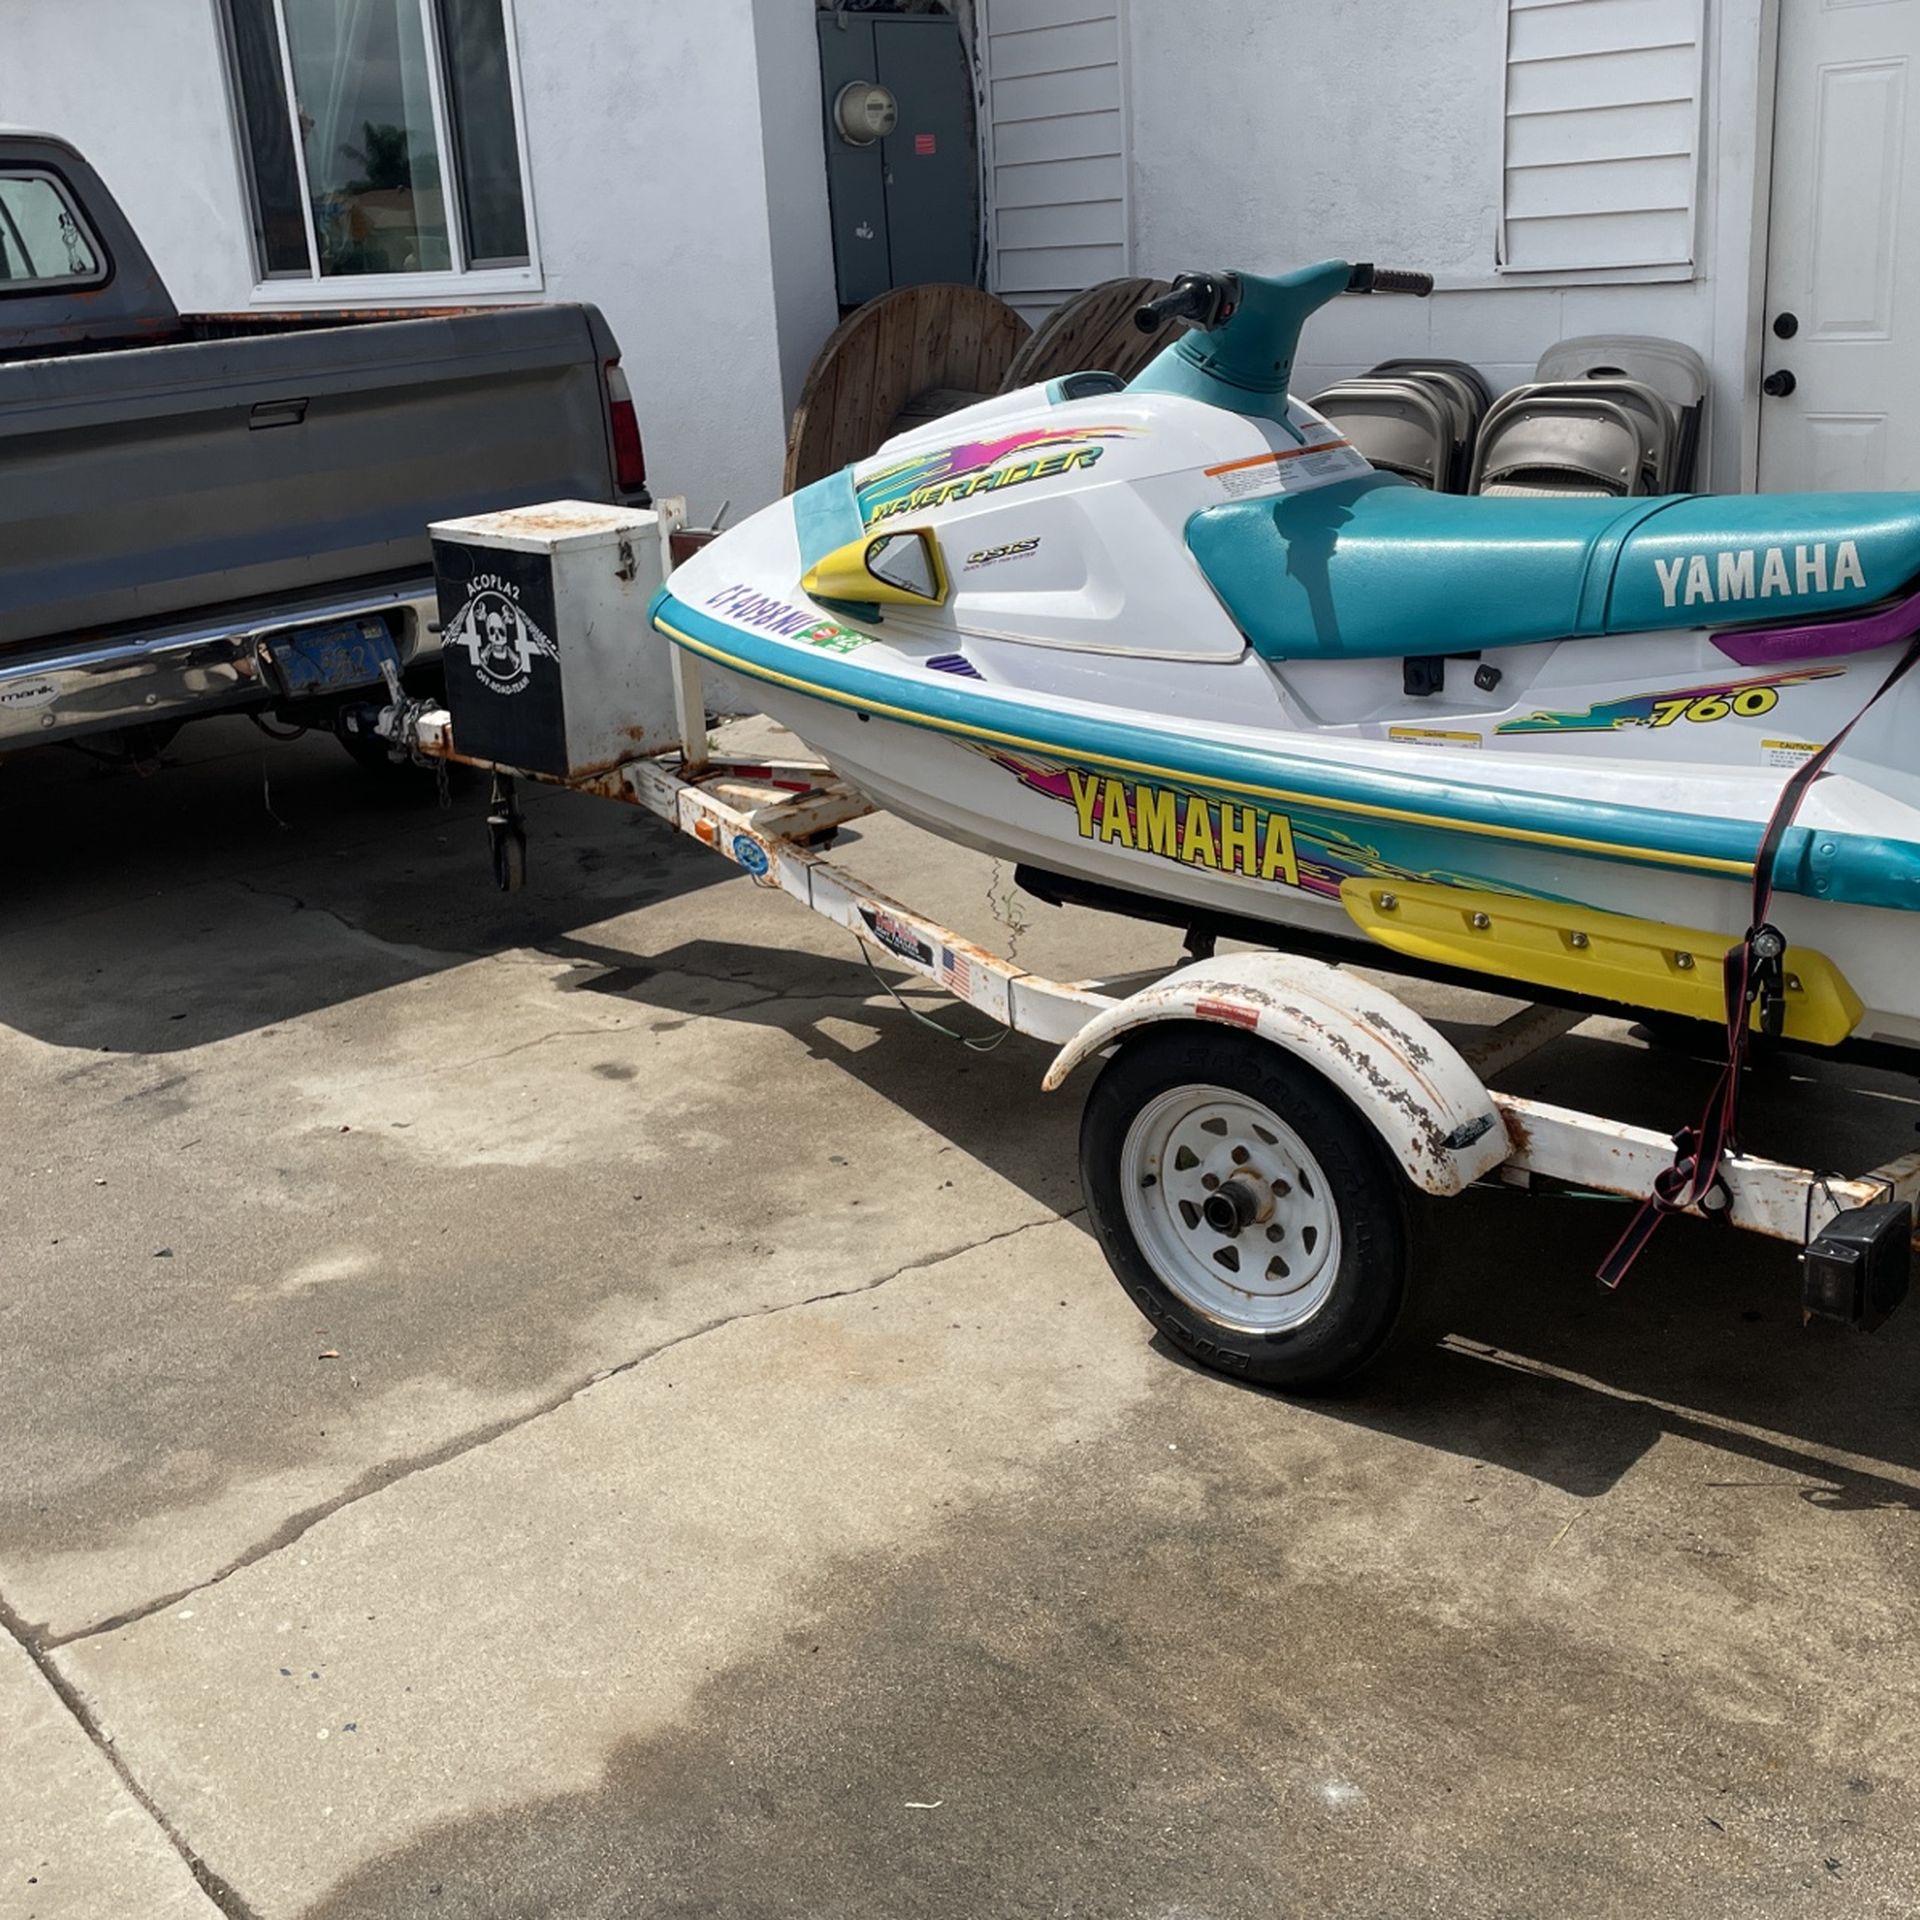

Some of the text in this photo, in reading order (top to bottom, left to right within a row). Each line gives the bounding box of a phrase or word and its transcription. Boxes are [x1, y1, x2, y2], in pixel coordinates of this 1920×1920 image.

[1654, 540, 1866, 608] YAMAHA
[1651, 686, 1779, 728] 760
[1779, 742, 1814, 754] CAUTION
[1067, 769, 1300, 885] YAMAHA
